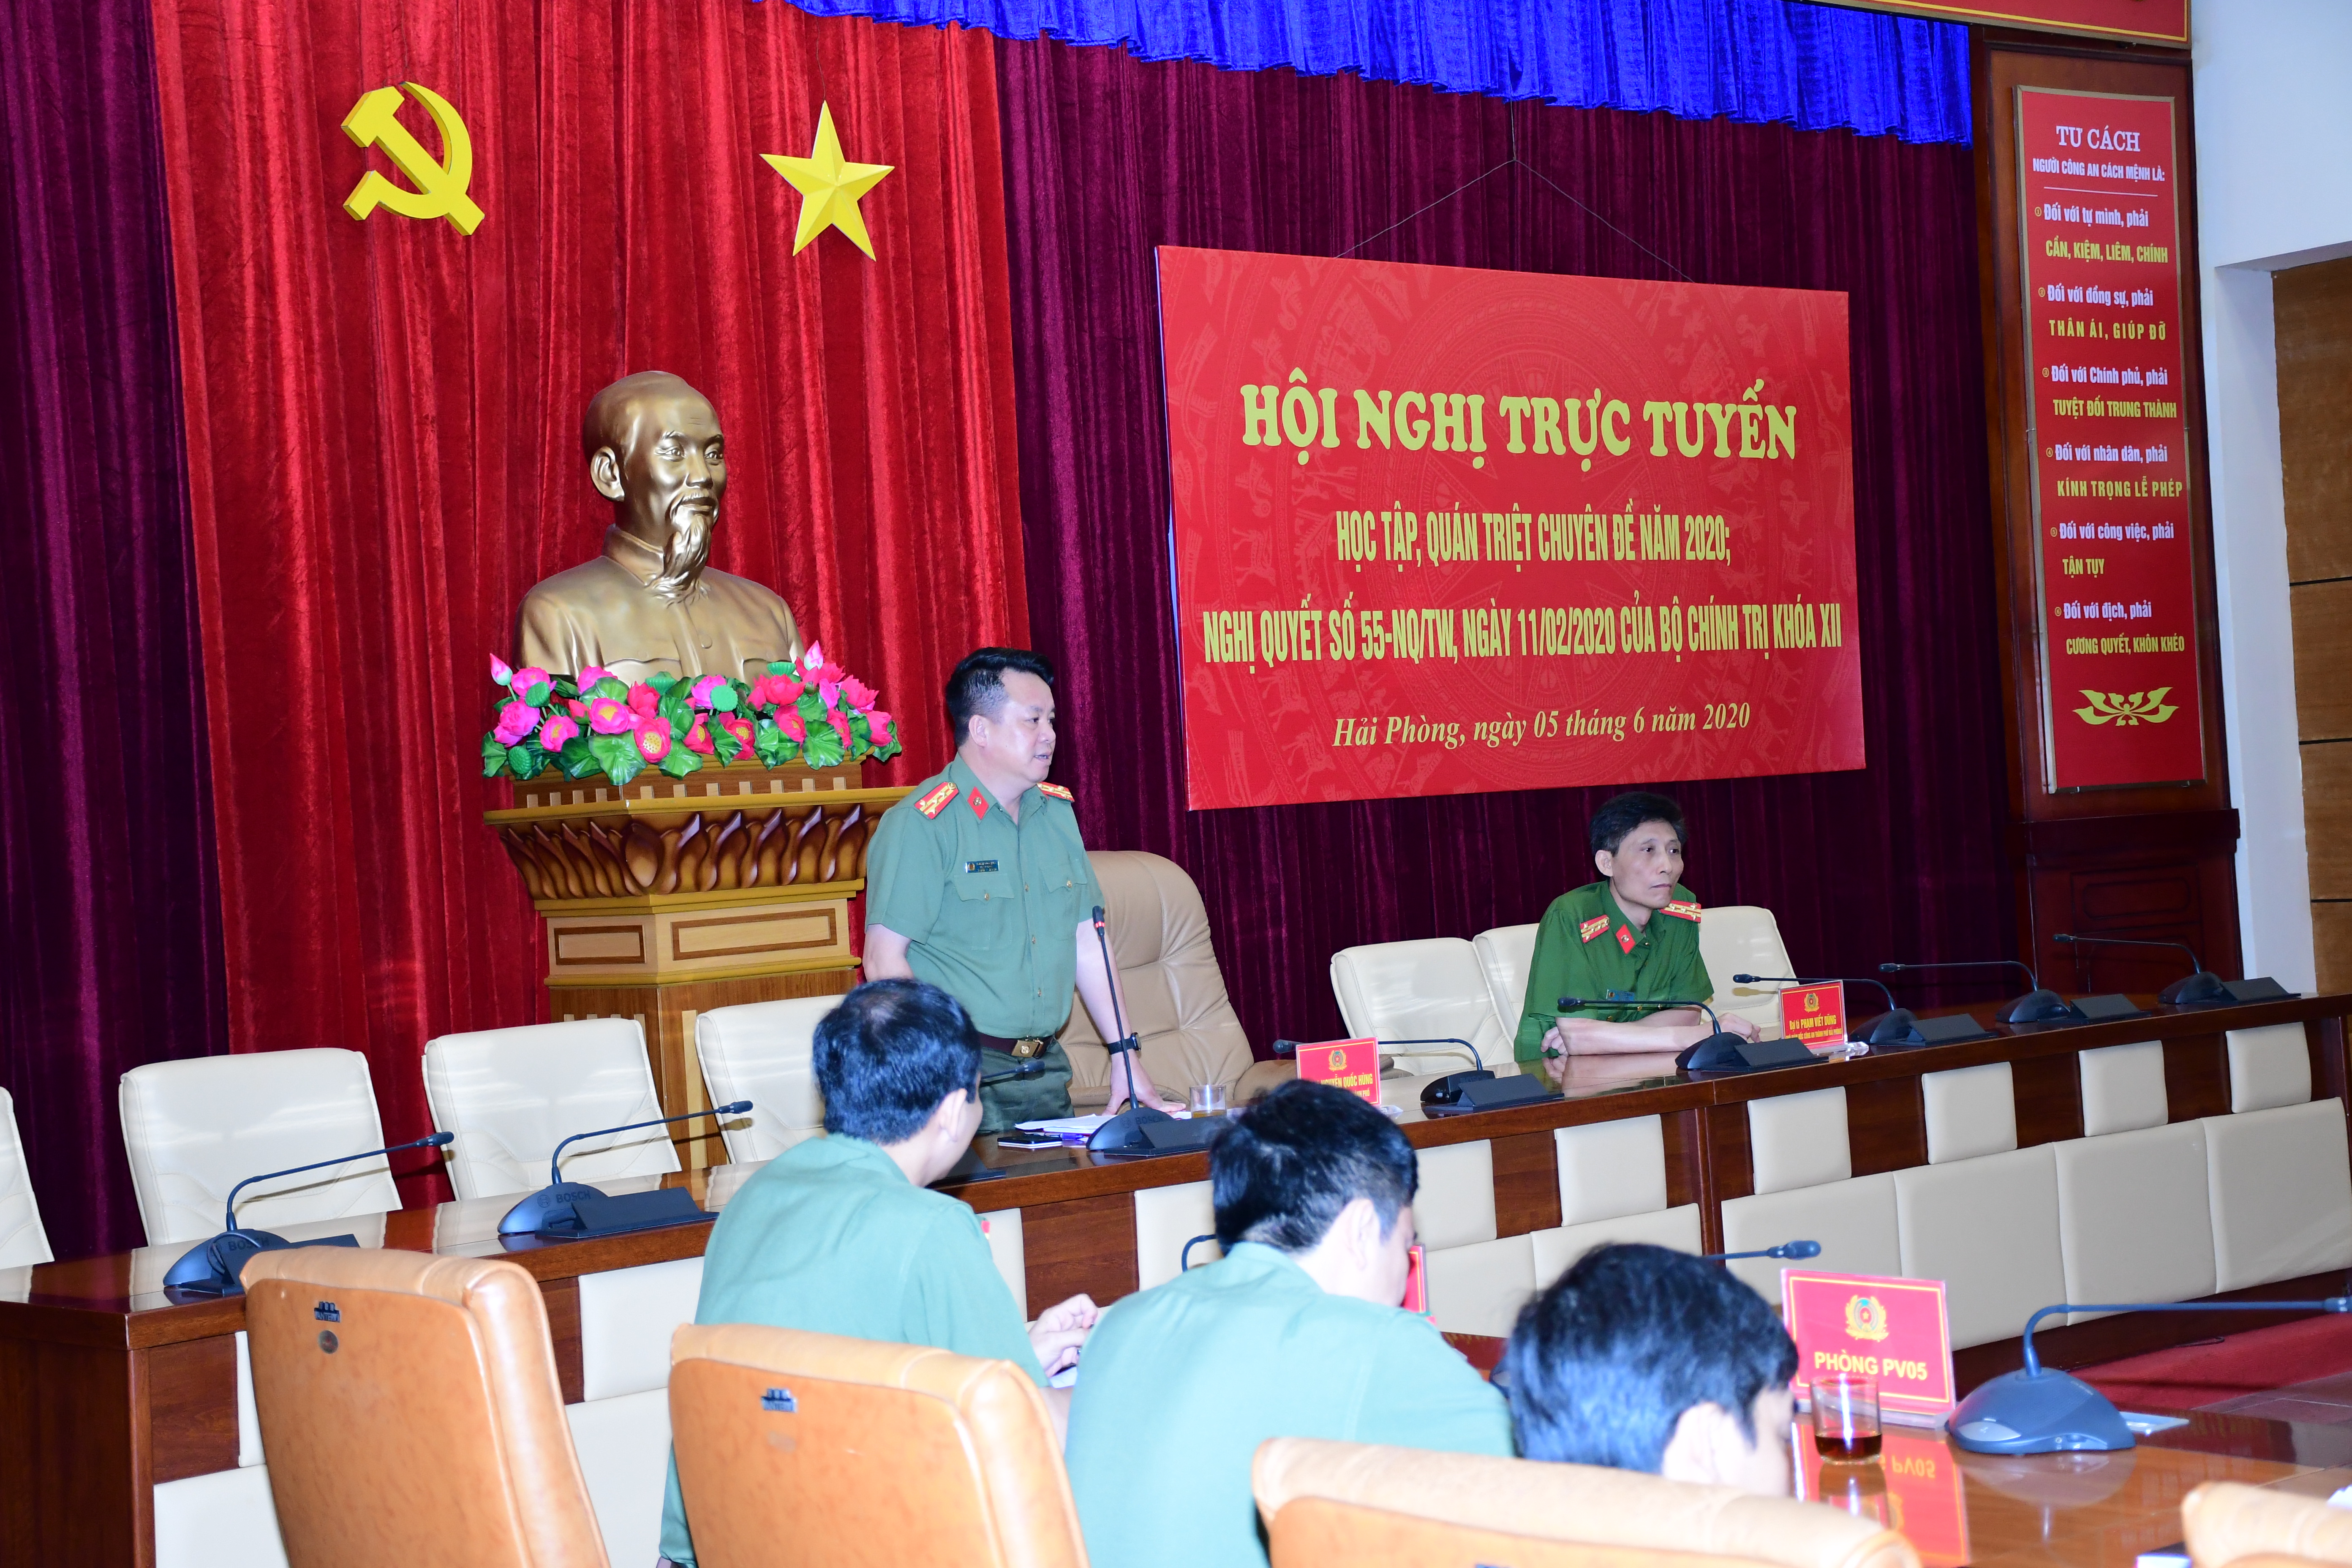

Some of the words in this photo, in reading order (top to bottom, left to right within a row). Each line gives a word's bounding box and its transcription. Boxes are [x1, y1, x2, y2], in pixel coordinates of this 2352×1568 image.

[2056, 126, 2082, 147] TƯ
[2088, 125, 2140, 152] CÁCH
[2033, 157, 2059, 173] NGƯỜI
[2062, 159, 2085, 175] CÔNG
[2087, 163, 2099, 177] AN
[2101, 162, 2123, 178] CÁCH
[2126, 164, 2150, 182] MỆNH
[2152, 166, 2165, 181] LÀ:
[2044, 202, 2061, 220] Đối
[2064, 206, 2080, 222] với
[2082, 207, 2093, 226] tự
[2095, 208, 2123, 227] mình,
[2127, 209, 2148, 227] phải
[2046, 235, 2071, 259] CẦN,
[2074, 240, 2103, 262] KIỆM,
[2106, 242, 2134, 263] LIÊM,
[2137, 243, 2168, 263] CHÍNH
[2047, 283, 2065, 301] Đối
[2067, 286, 2083, 302] với
[2086, 285, 2111, 306] đồng
[2114, 291, 2129, 308] sự,
[2132, 288, 2153, 307] phải
[2049, 318, 2084, 337] THÂN
[2090, 318, 2108, 340] ÁI,
[2113, 320, 2144, 339] GIÚP
[2149, 321, 2165, 340] ĐỠ
[2051, 364, 2069, 382] Đối
[2071, 366, 2087, 382] với
[2090, 367, 2119, 383] Chính
[2122, 367, 2143, 386] phủ,
[2146, 368, 2167, 386] phải
[2053, 397, 2084, 419] TUYỆT
[2087, 395, 2104, 416] ĐỐI
[2107, 401, 2141, 417] TRUNG
[2143, 399, 2177, 418] THÀNH
[1240, 367, 1340, 466] HỘI
[1353, 389, 1487, 469] NGHỊ
[1499, 388, 1631, 472] TRỰC
[1643, 378, 1797, 460] TUYẾN
[2055, 442, 2072, 460] Đối
[2075, 445, 2091, 461] với
[2093, 445, 2118, 461] nhân
[2121, 446, 2143, 463] dân,
[2146, 444, 2167, 463] phải
[2058, 477, 2087, 496] KÍNH
[2091, 481, 2131, 500] TRỌNG
[2135, 476, 2148, 497] LỄ
[2152, 478, 2182, 497] PHÉP
[1336, 510, 1377, 572] HỌC
[1381, 501, 1421, 572] TẬP,
[1426, 501, 1478, 567] QUÁN
[1482, 503, 1532, 572] TRIỆT
[1538, 504, 1609, 561] CHUYÊN
[1612, 498, 1636, 561] ĐỀ
[1639, 504, 1680, 561] NĂM
[1685, 514, 1731, 566] 2020;
[2060, 521, 2077, 539] Đối
[2079, 523, 2095, 539] với
[2098, 523, 2123, 540] công
[2125, 523, 2150, 542] việc,
[2152, 521, 2174, 540] phải
[2062, 555, 2083, 578] TẬN
[2085, 559, 2104, 577] TỤY
[2063, 600, 2081, 618] Đối
[2083, 602, 2099, 618] với
[2102, 602, 2127, 621] địch,
[2130, 600, 2151, 619] phải
[1203, 610, 1255, 674] NGHỊ
[1260, 593, 1322, 668] QUYẾT
[1328, 591, 1356, 661] SỐ
[1360, 608, 1458, 664] 55-NQ/TW,
[1462, 598, 1511, 658] NGÀY
[1517, 607, 1616, 656] 11/02/2020
[1620, 590, 1656, 653] CỦA
[1659, 596, 1683, 662] BỘ
[1687, 595, 1739, 652] CHÍNH
[1742, 604, 1769, 660] TRỊ
[1772, 593, 1817, 649] KHÓA
[1819, 603, 1842, 648] XII
[2066, 637, 2098, 654] CƯƠNG
[2101, 633, 2131, 655] QUYẾT,
[2133, 634, 2158, 652] KHÔN
[2161, 633, 2184, 651] KHÉO
[1331, 717, 1377, 746] Hải
[1383, 715, 1465, 749] Phòng,
[1473, 712, 1527, 748] ngày
[1534, 710, 1559, 738] 05
[1565, 708, 1627, 742] tháng
[1633, 706, 1645, 733] 6
[1652, 705, 1696, 732] năm
[1702, 702, 1750, 730] 2020
[1801, 1018, 1814, 1030] PHẠM
[1343, 1072, 1357, 1088] QUỐC
[1358, 1073, 1373, 1085] HÙNG
[555, 1190, 591, 1203] BOSCH
[227, 1237, 270, 1251] BOH
[1814, 1349, 1879, 1375] PHÒNG
[1882, 1358, 1928, 1380] PV05
